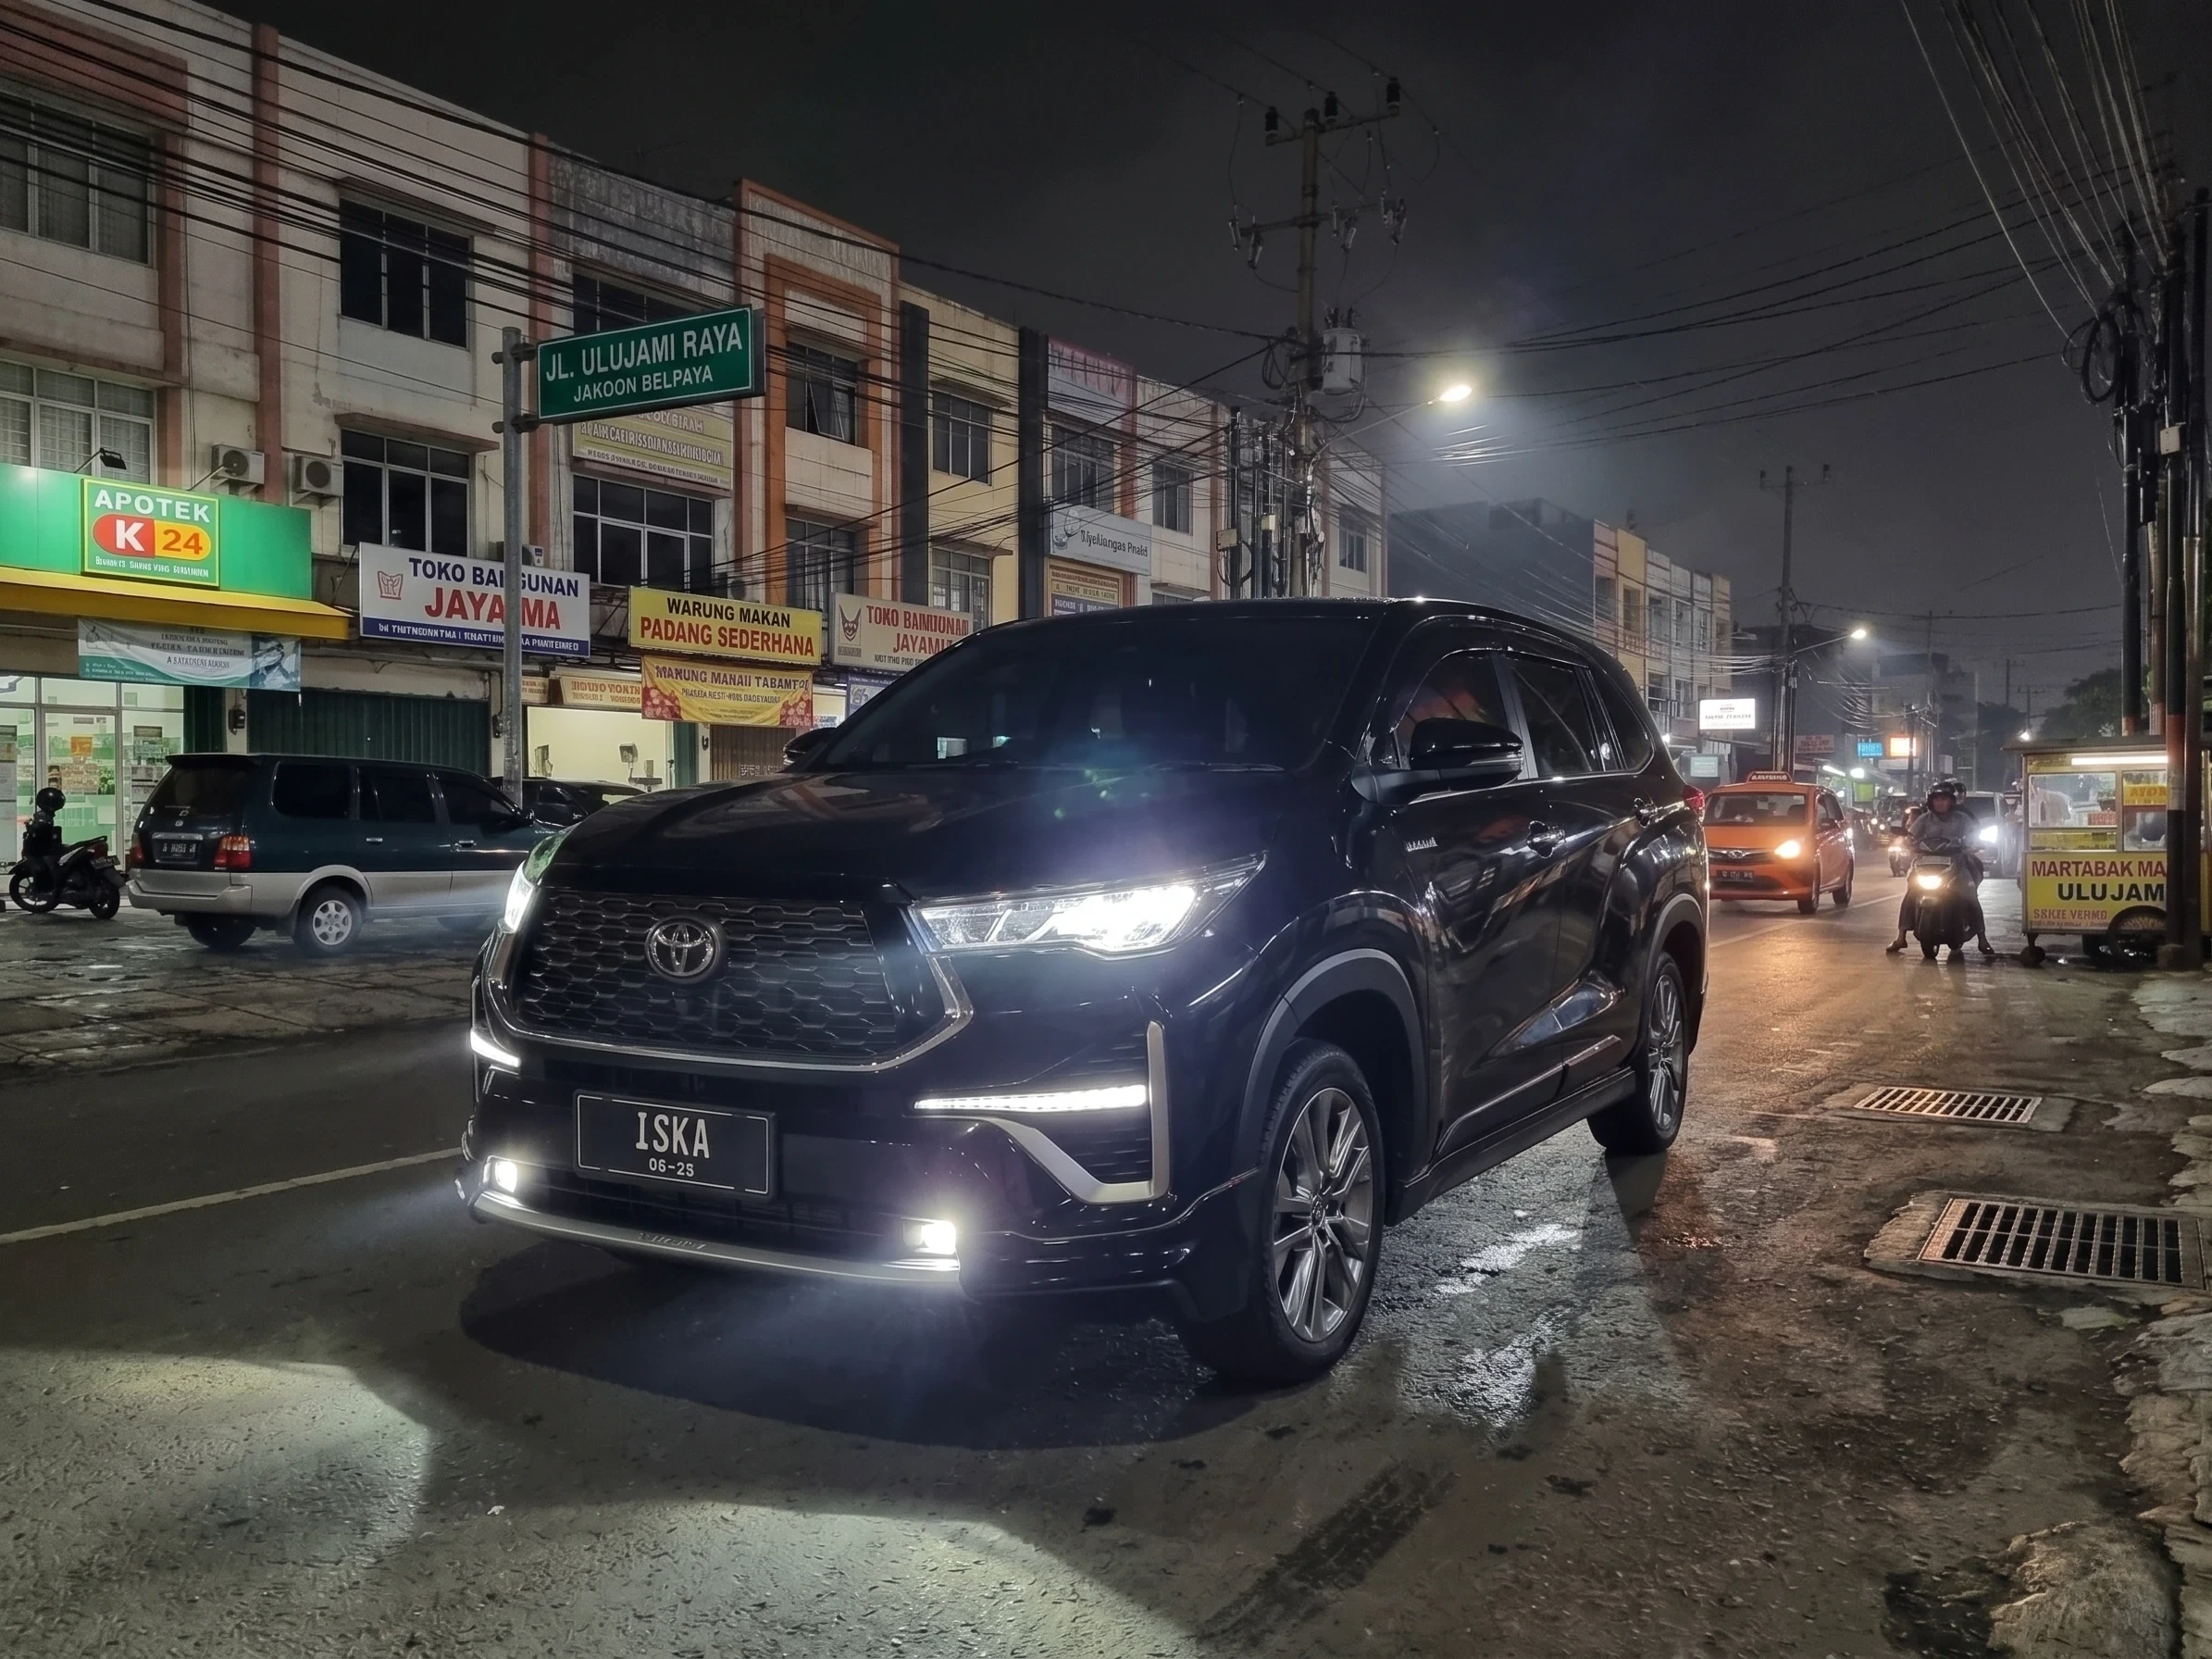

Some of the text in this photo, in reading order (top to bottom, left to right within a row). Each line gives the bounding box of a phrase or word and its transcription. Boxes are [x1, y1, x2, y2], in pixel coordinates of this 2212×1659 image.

[546, 322, 743, 381] JL. ULUJAMI RAYA
[573, 365, 714, 403] JAKOON BELPAYA
[94, 489, 211, 523] APOTEK
[116, 518, 204, 555] K 24
[408, 556, 466, 583] TOKO
[666, 597, 790, 629] WARUNG MAKAN
[866, 605, 900, 628] TOKO
[640, 616, 814, 657] PADANG SEDERHANA
[2032, 860, 2134, 878] MARTABAK
[635, 1111, 710, 1159] ISKA
